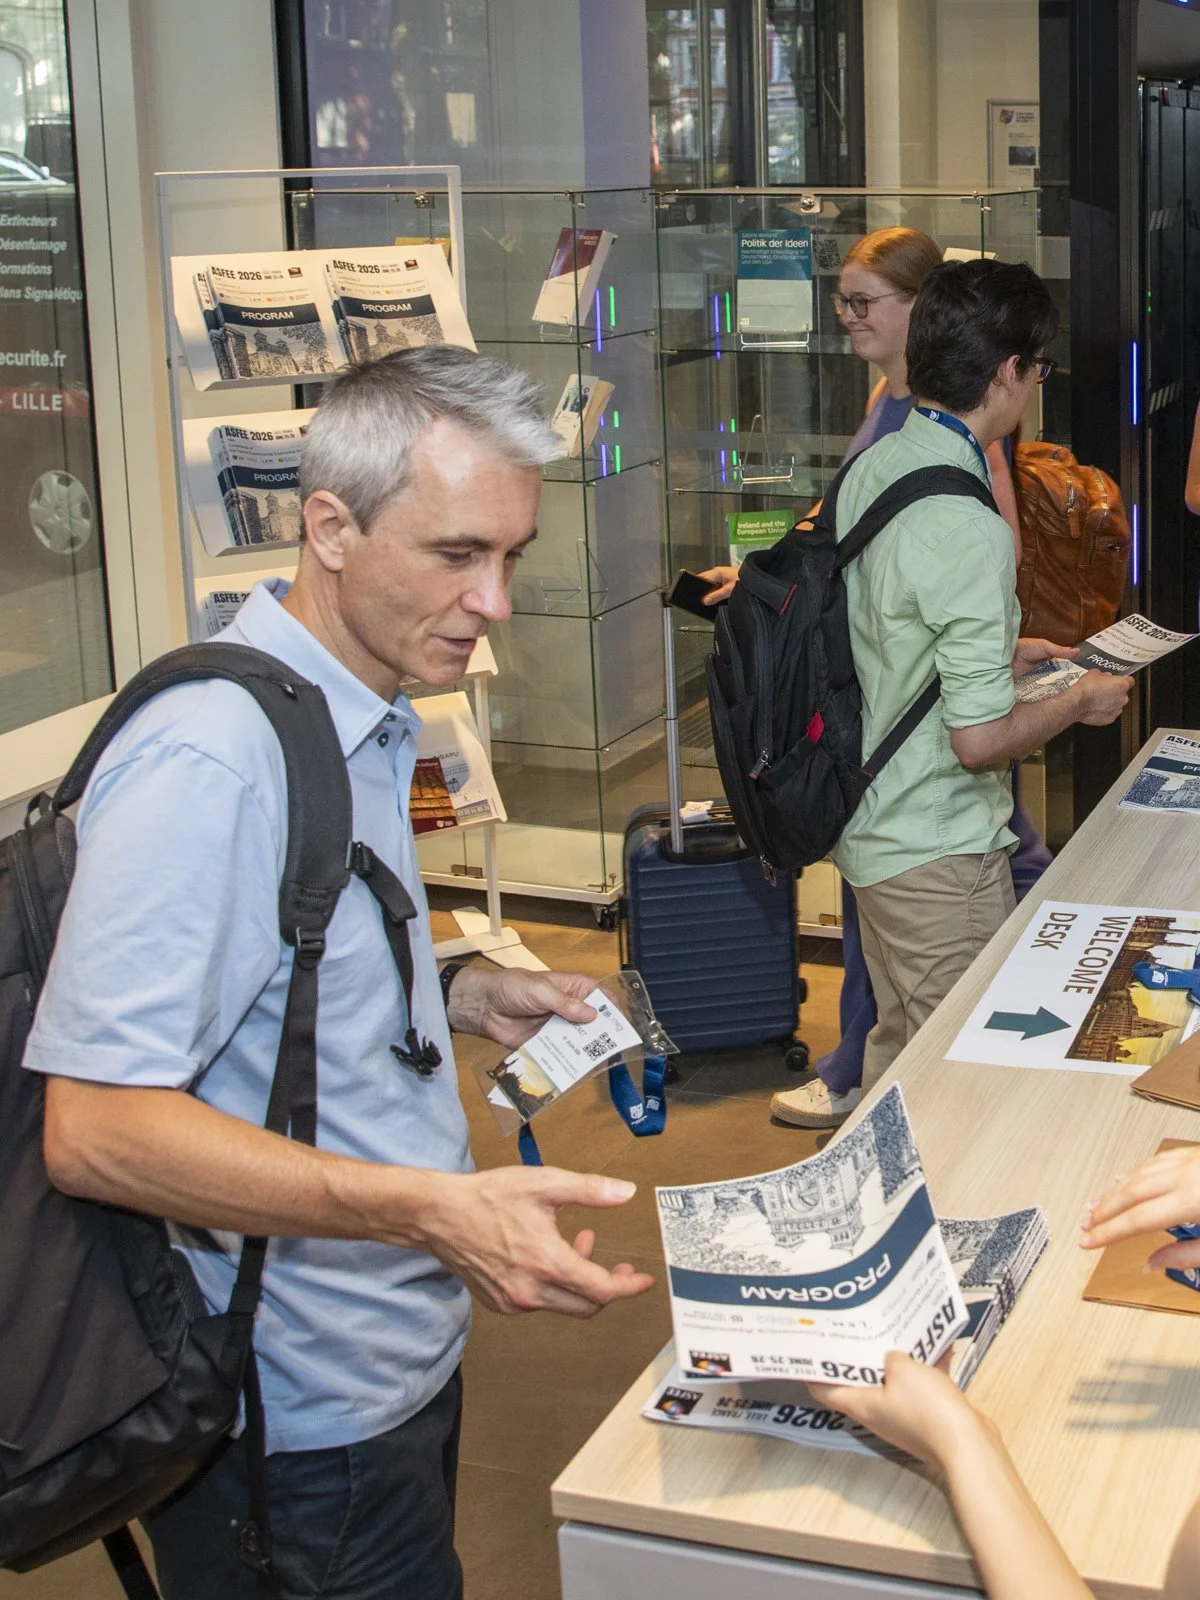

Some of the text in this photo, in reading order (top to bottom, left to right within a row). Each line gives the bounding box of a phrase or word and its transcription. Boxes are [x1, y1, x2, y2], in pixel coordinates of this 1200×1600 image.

[741, 239, 809, 248] Politik der Ideen
[0, 263, 53, 275] ormations
[211, 266, 236, 279] ASFEE
[237, 271, 262, 281] 2026
[333, 259, 357, 273] ASFEE
[357, 264, 380, 274] 2026
[0, 286, 22, 299] lans
[361, 303, 413, 313] PROGRAM
[241, 311, 294, 321] PROGRAM
[12, 392, 63, 412] LILLE
[225, 427, 248, 440] ASFEE
[250, 431, 274, 441] 2026
[737, 528, 767, 536] European
[213, 592, 240, 604] ASFEE
[1123, 615, 1152, 632] ASFEE
[1030, 911, 1078, 950] DESK
[1062, 916, 1132, 994] WELCOME
[740, 1253, 892, 1302] PROGRAM
[666, 1386, 701, 1401] ASFEE
[772, 1403, 849, 1431] 2026
